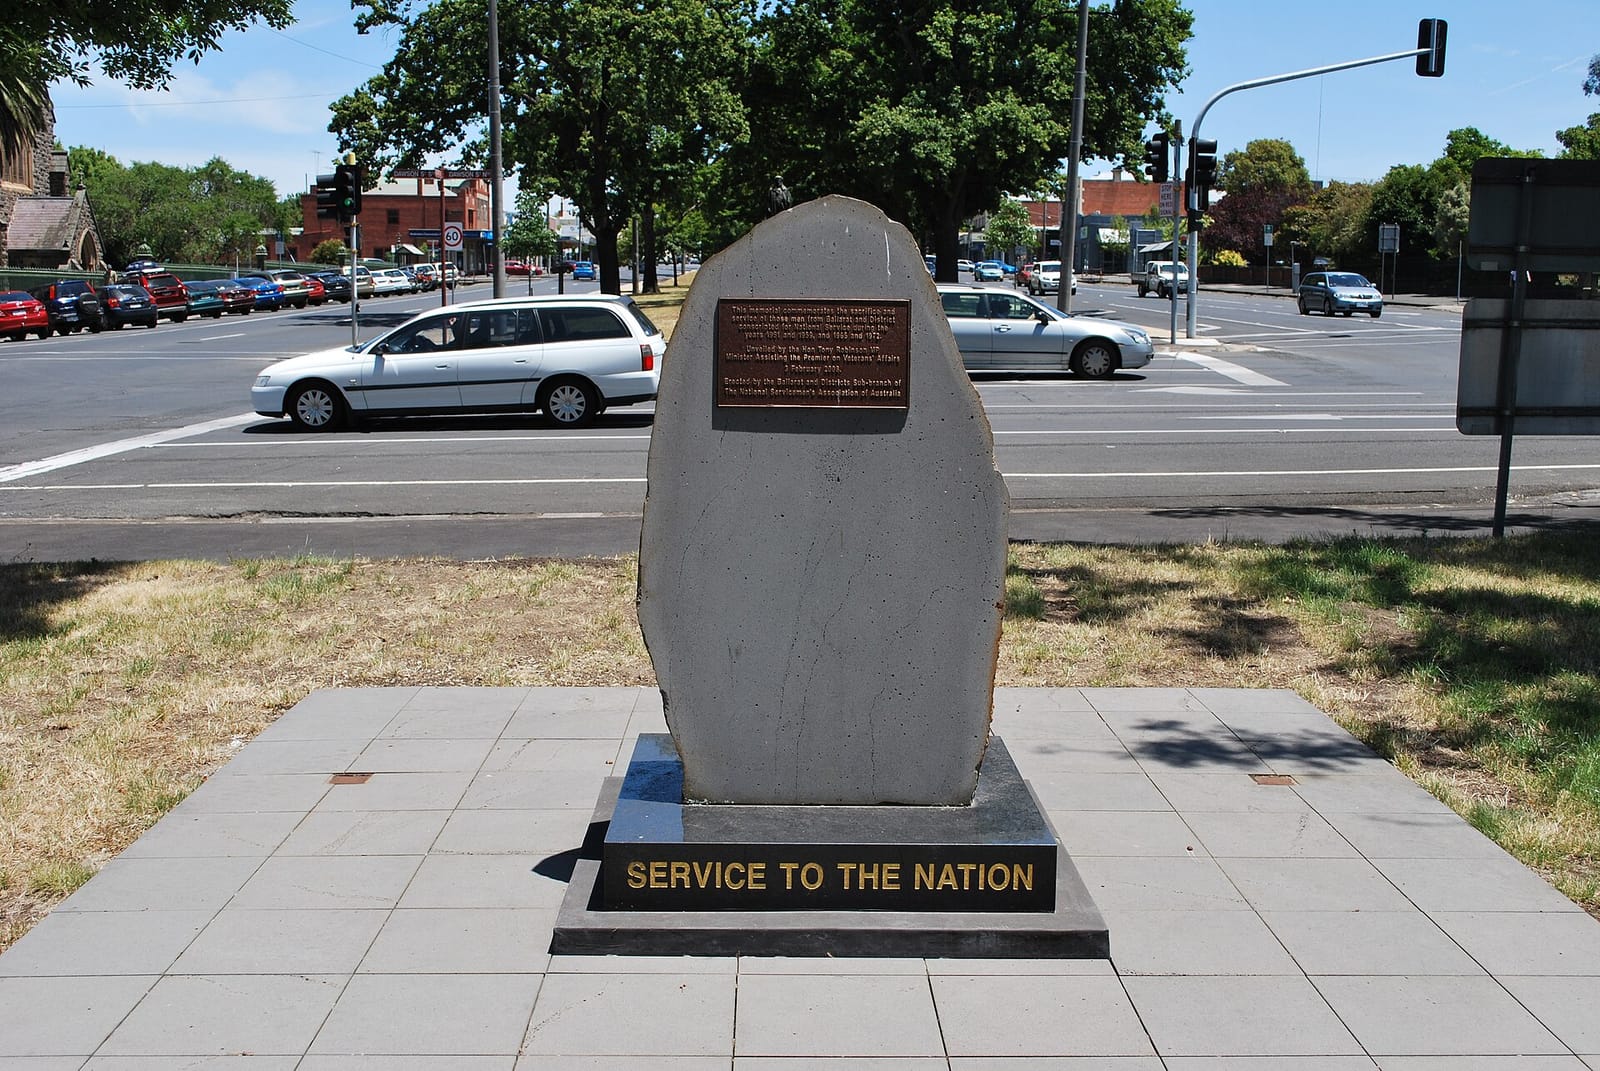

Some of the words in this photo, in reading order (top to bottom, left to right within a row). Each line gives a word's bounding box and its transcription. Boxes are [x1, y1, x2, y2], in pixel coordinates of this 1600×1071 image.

[445, 231, 459, 241] 60
[732, 306, 747, 314] This
[749, 306, 781, 314] memorial
[783, 306, 834, 314] commemorates
[850, 307, 881, 315] sacrifice
[883, 307, 896, 315] and
[738, 323, 779, 332] conscripted
[852, 324, 875, 332] during
[744, 331, 764, 340] years
[746, 345, 776, 353] Unveiled
[778, 346, 786, 354] by
[818, 346, 834, 354] Tony
[725, 353, 753, 361] Minister
[755, 353, 787, 362] Assisting
[842, 354, 874, 362] Veterans'
[877, 354, 900, 362] Affairs
[791, 365, 822, 373] February
[724, 377, 750, 385] Erected
[752, 378, 761, 386] by
[820, 378, 850, 386] Districts
[870, 389, 901, 397] Australia
[626, 861, 767, 890] SERVICE
[779, 862, 825, 890] TO
[837, 863, 901, 890] THE
[914, 863, 1033, 890] NATION
